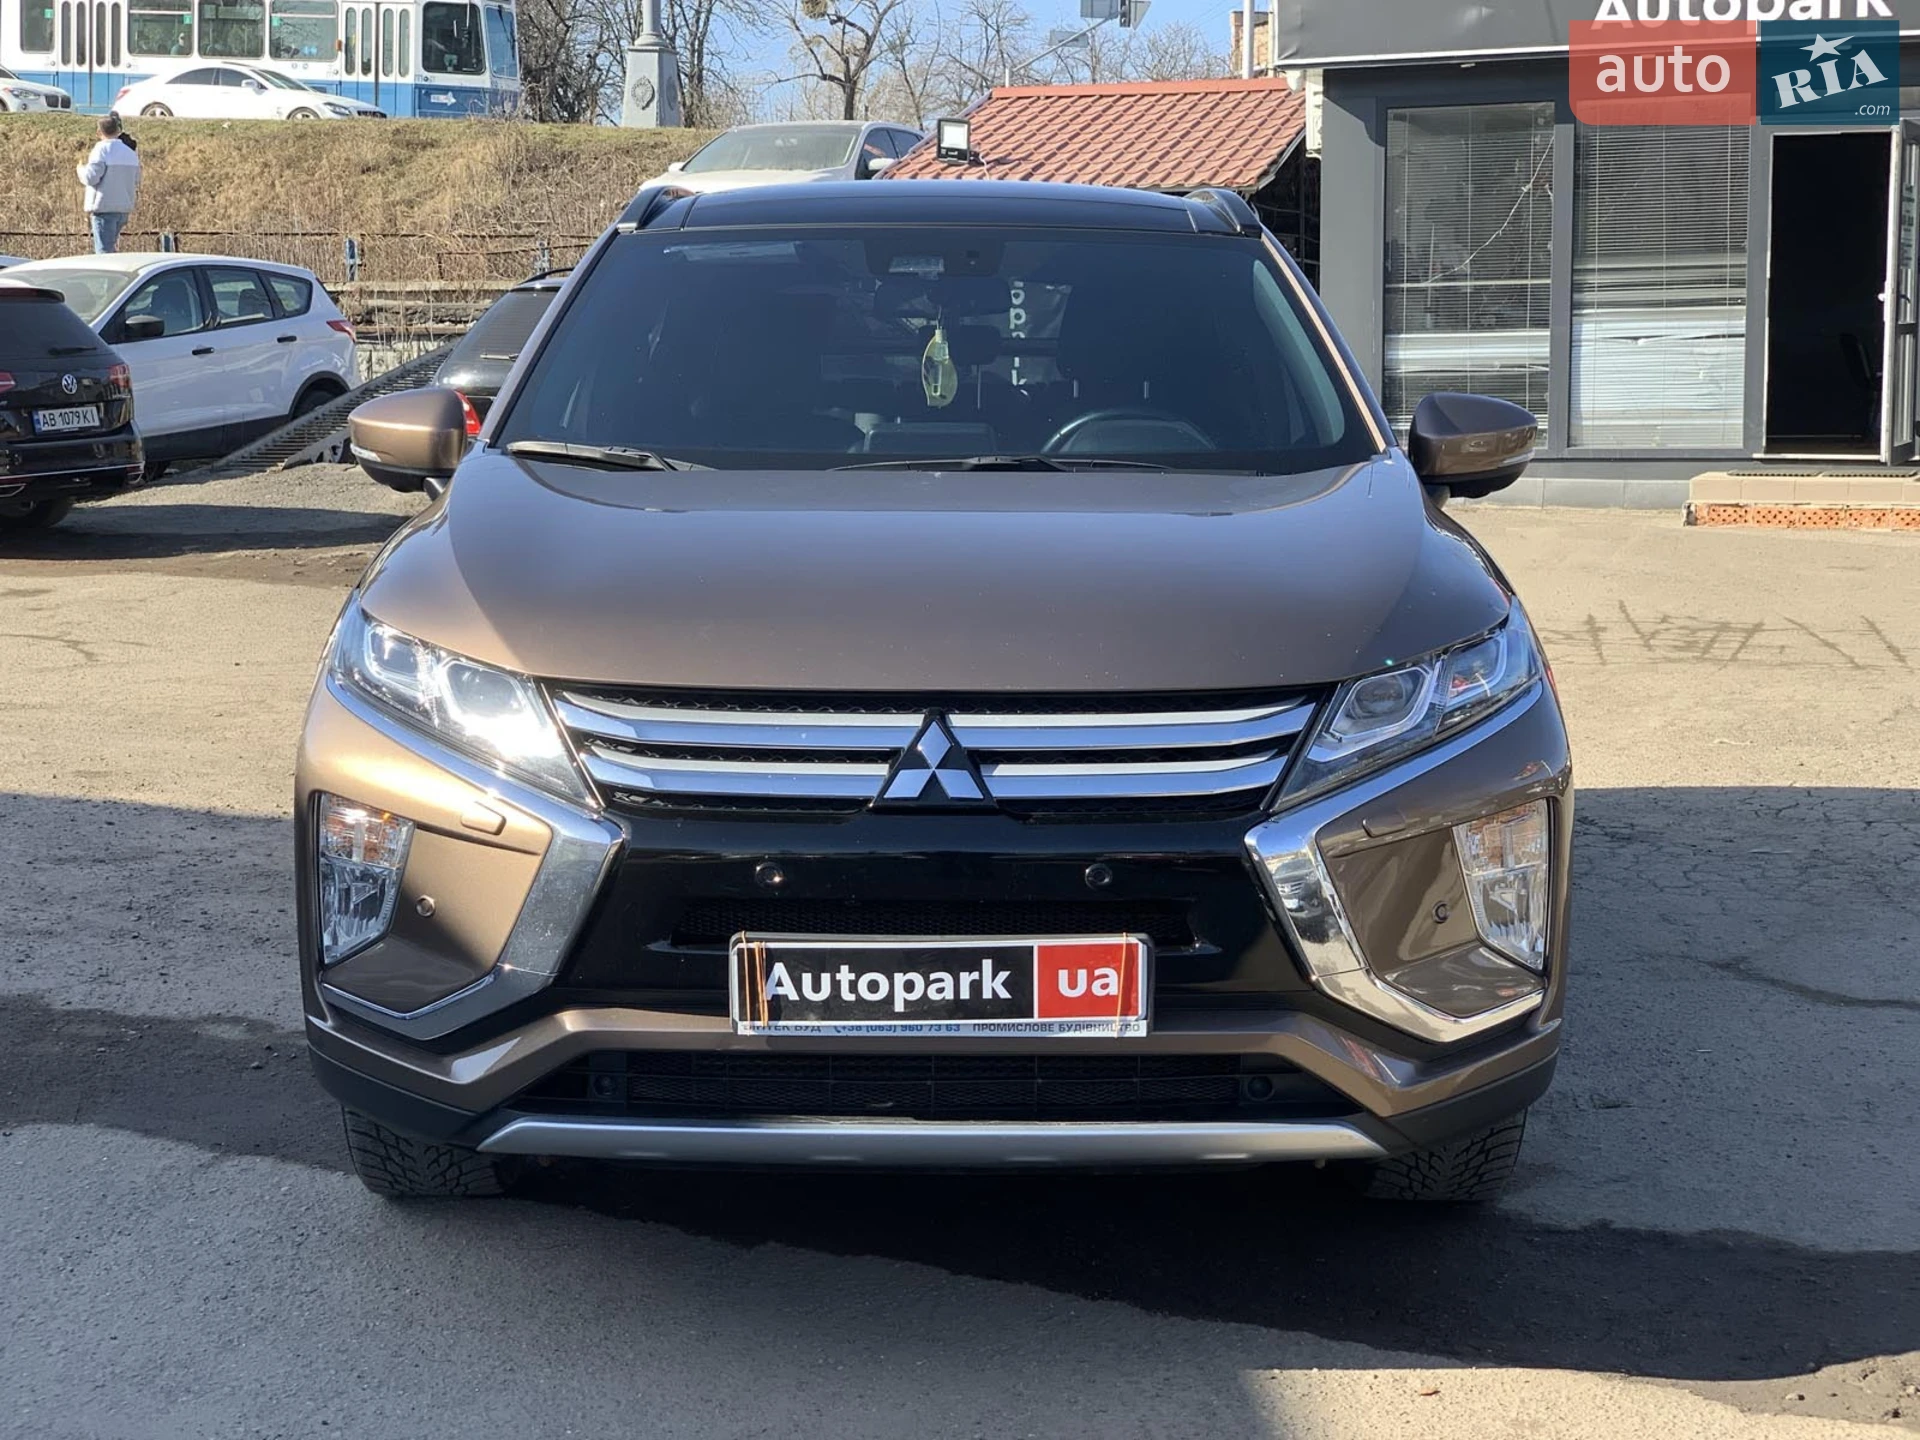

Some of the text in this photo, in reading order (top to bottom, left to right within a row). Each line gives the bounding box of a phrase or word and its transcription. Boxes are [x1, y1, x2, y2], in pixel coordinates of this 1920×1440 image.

[42, 408, 95, 428] AB 1079 KI
[765, 958, 1119, 1013] Autopark ua
[972, 1022, 1055, 1034] ПРОМИСЛОВЕ
